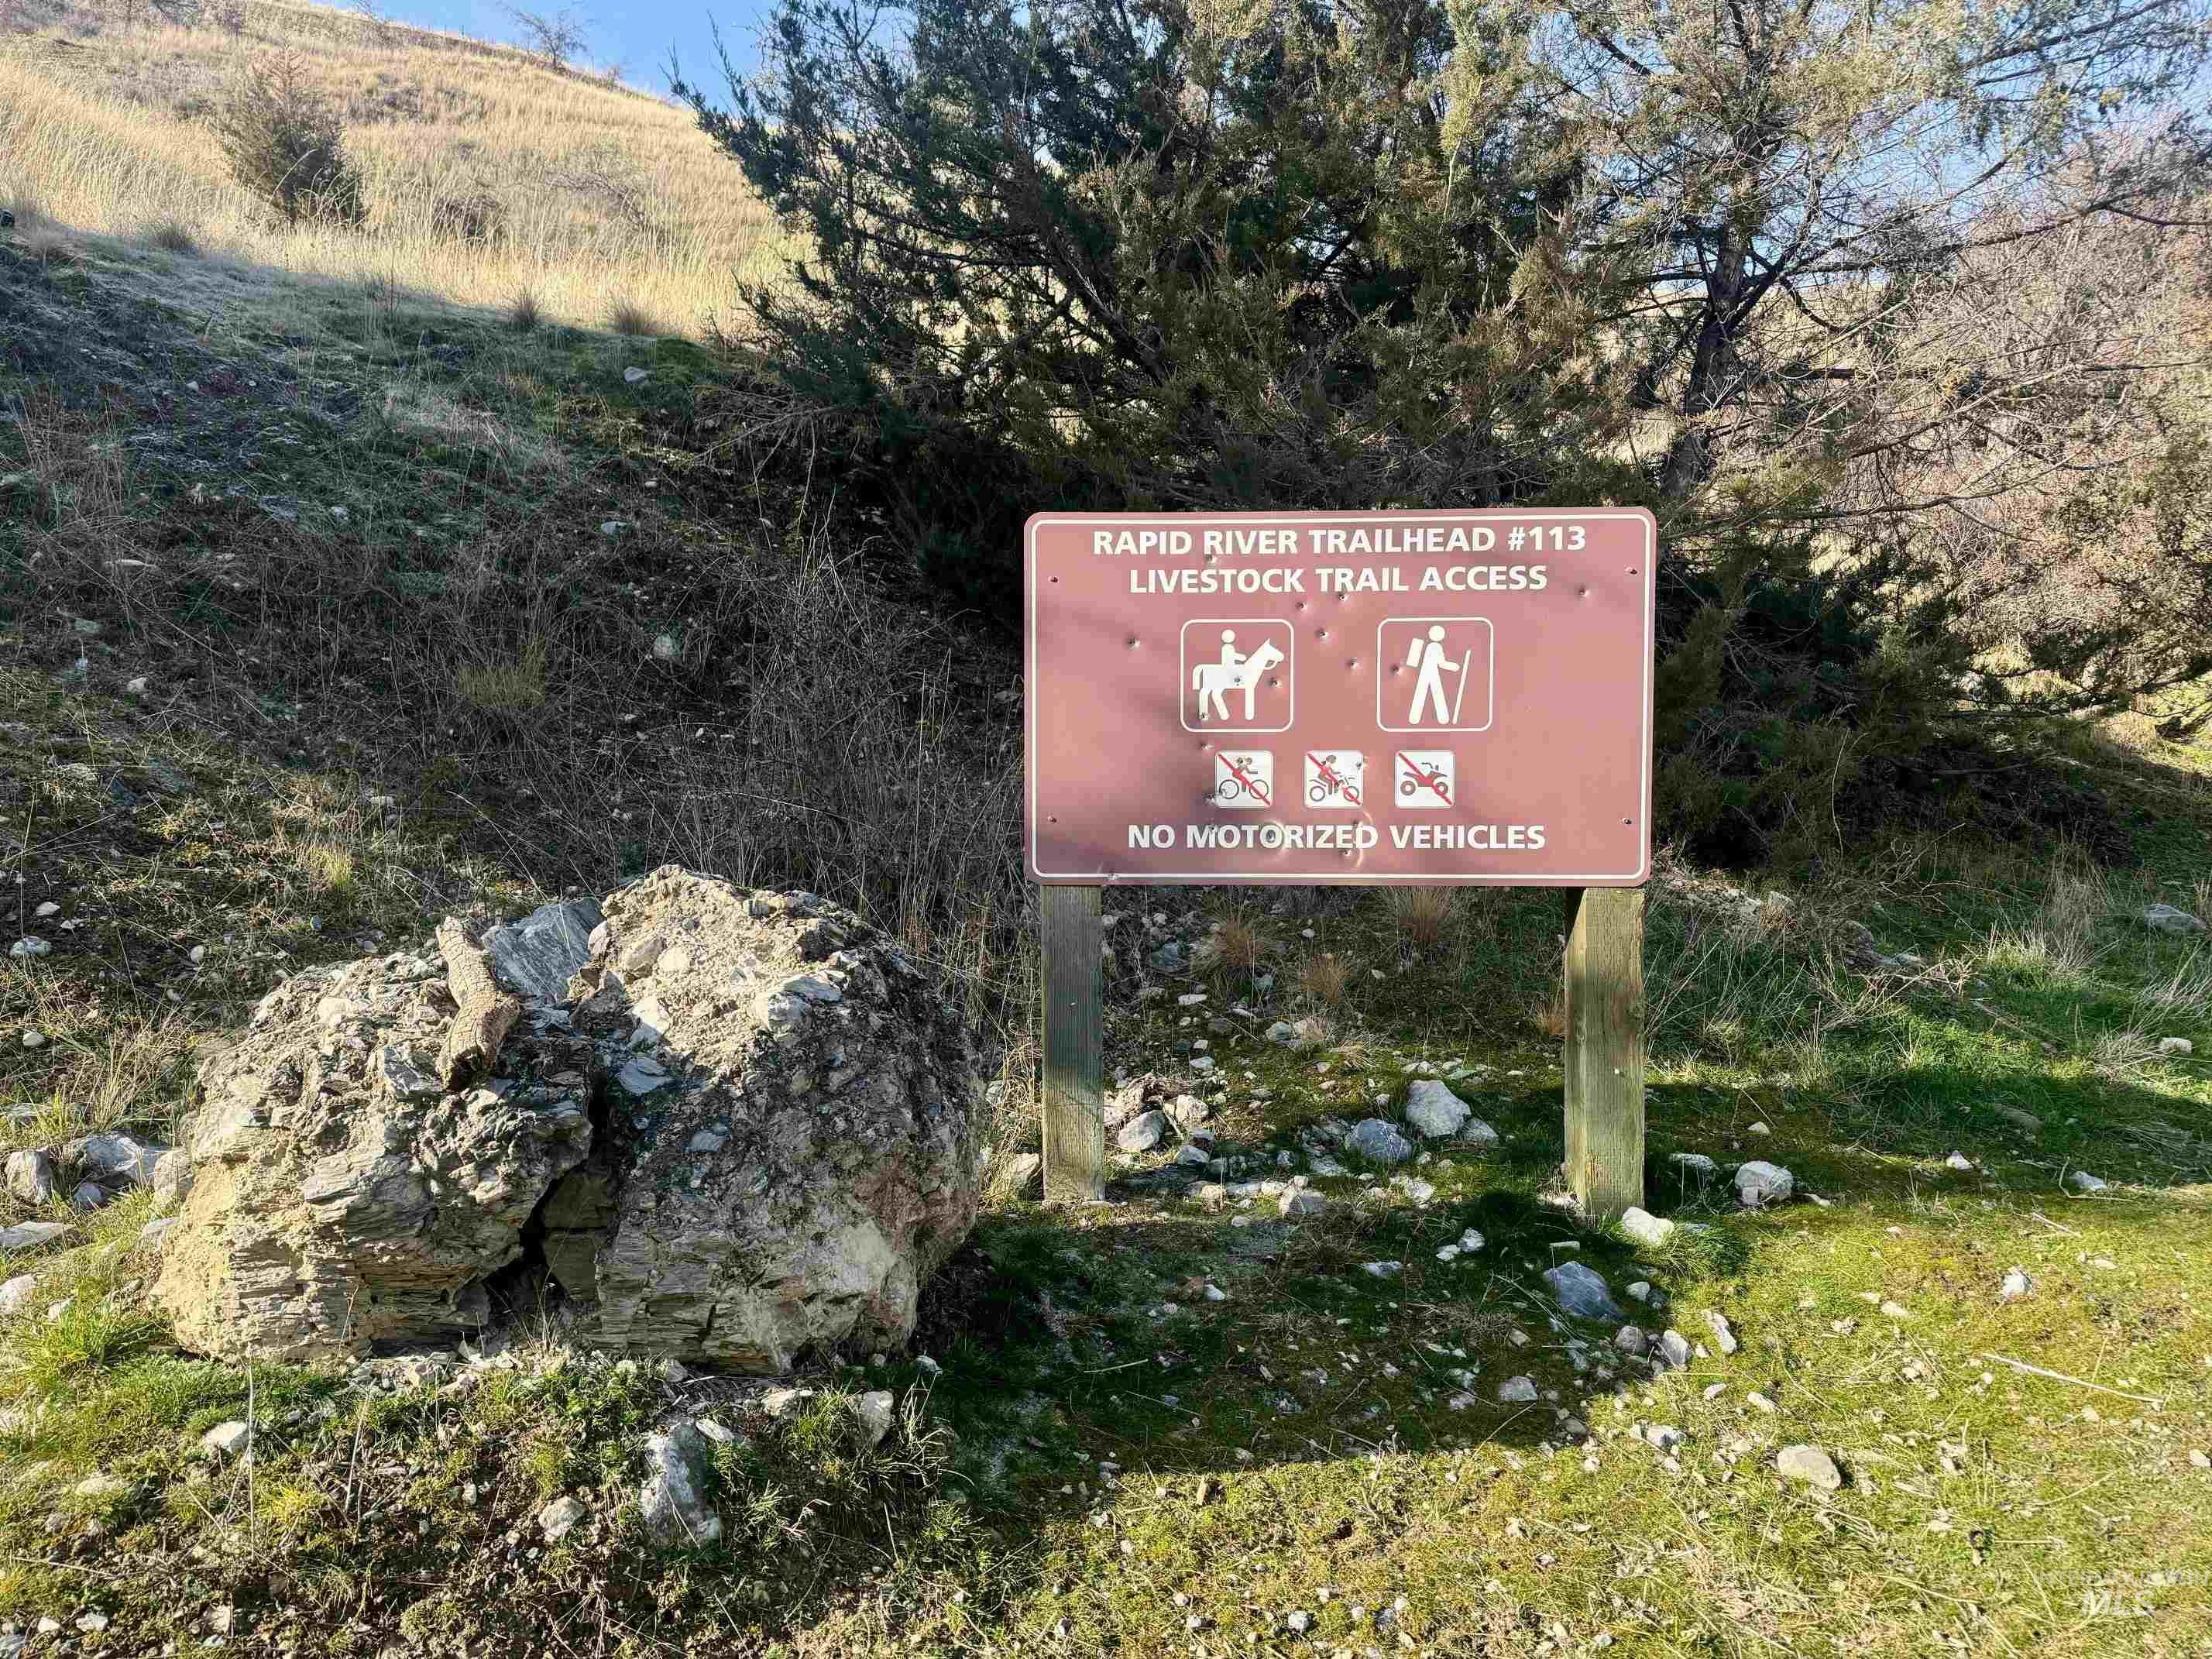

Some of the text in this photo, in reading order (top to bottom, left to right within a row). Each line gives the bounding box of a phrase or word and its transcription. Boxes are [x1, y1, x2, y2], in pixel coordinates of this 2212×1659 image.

[1094, 526, 1586, 555] RAPID RIVER TRAILHEAD #113
[1130, 565, 1547, 593] LIVESTOCK TRAIL ACCESS
[1128, 825, 1546, 849] NO MOTORIZED VEHICLES
